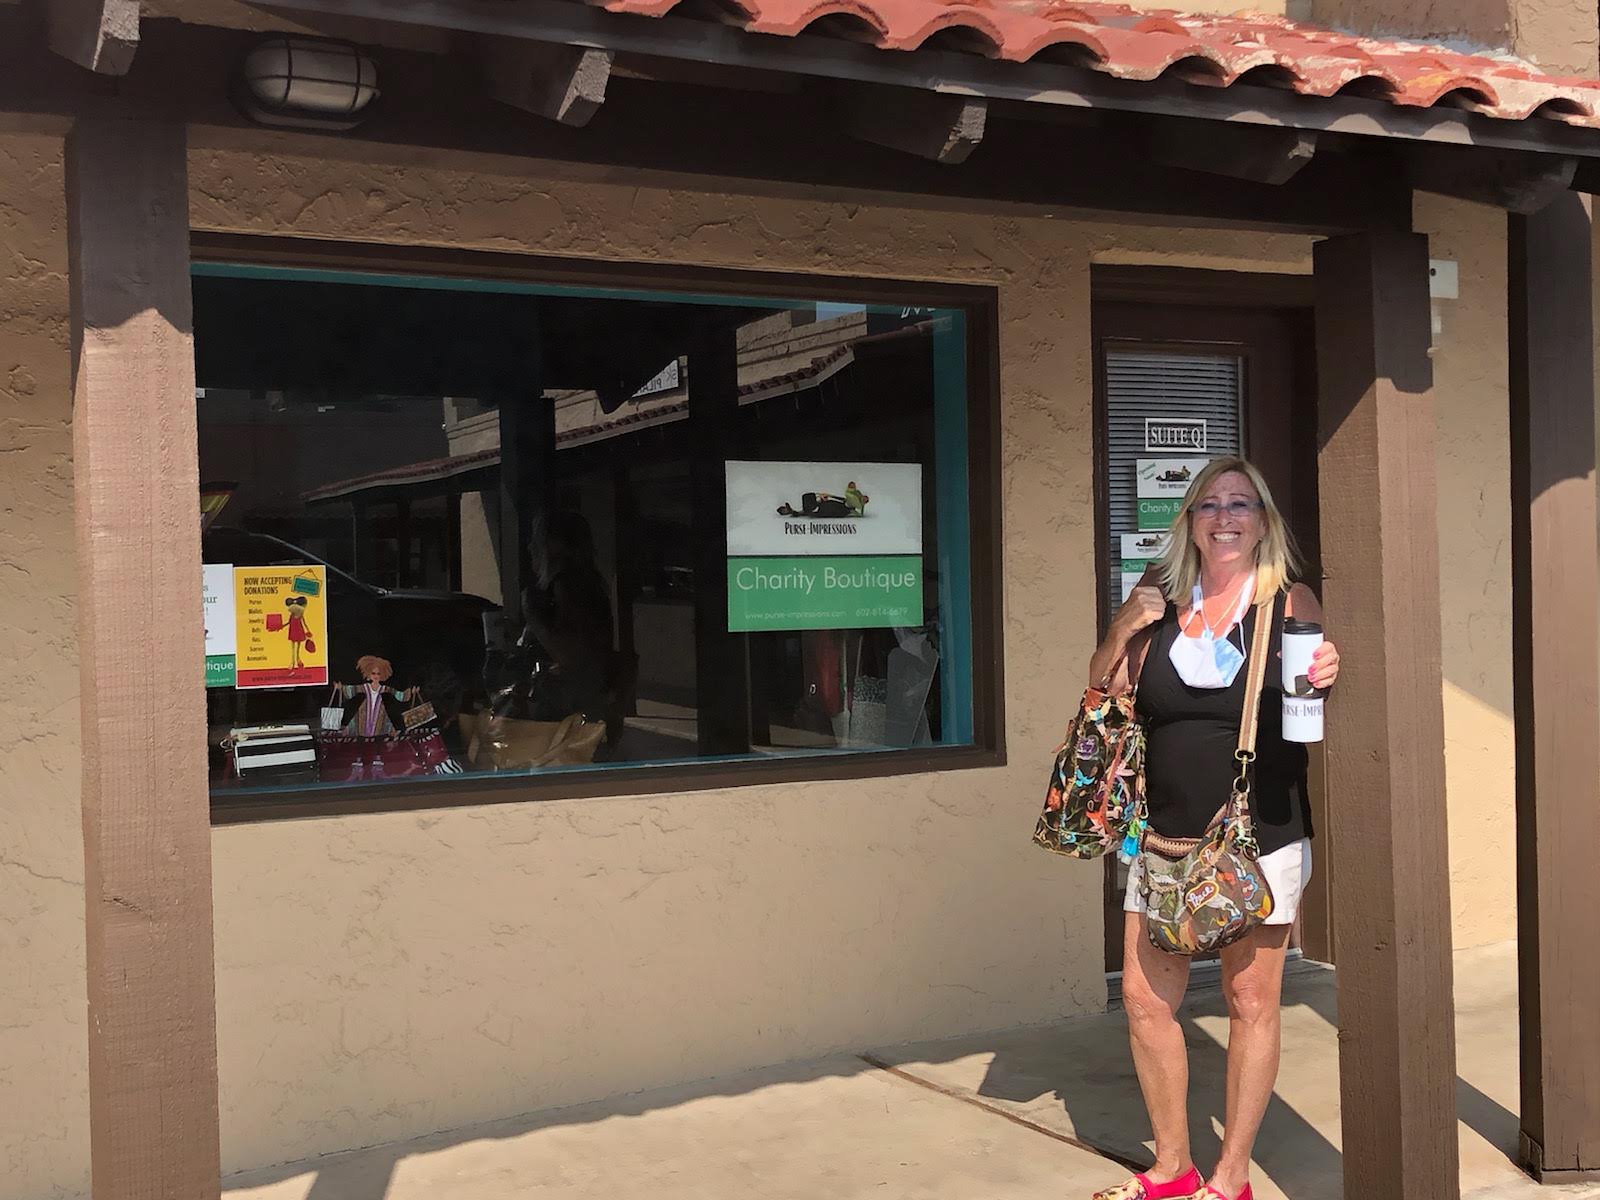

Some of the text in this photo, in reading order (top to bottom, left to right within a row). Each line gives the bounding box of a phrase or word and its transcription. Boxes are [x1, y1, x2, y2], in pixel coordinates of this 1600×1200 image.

[1151, 427, 1200, 448] SUITE Q
[1140, 502, 1171, 515] Charity
[244, 576, 292, 586] NOW ACCEPTING
[736, 566, 916, 595] Charity Boutique
[244, 586, 279, 595] DONATIONS
[206, 660, 234, 673] tique
